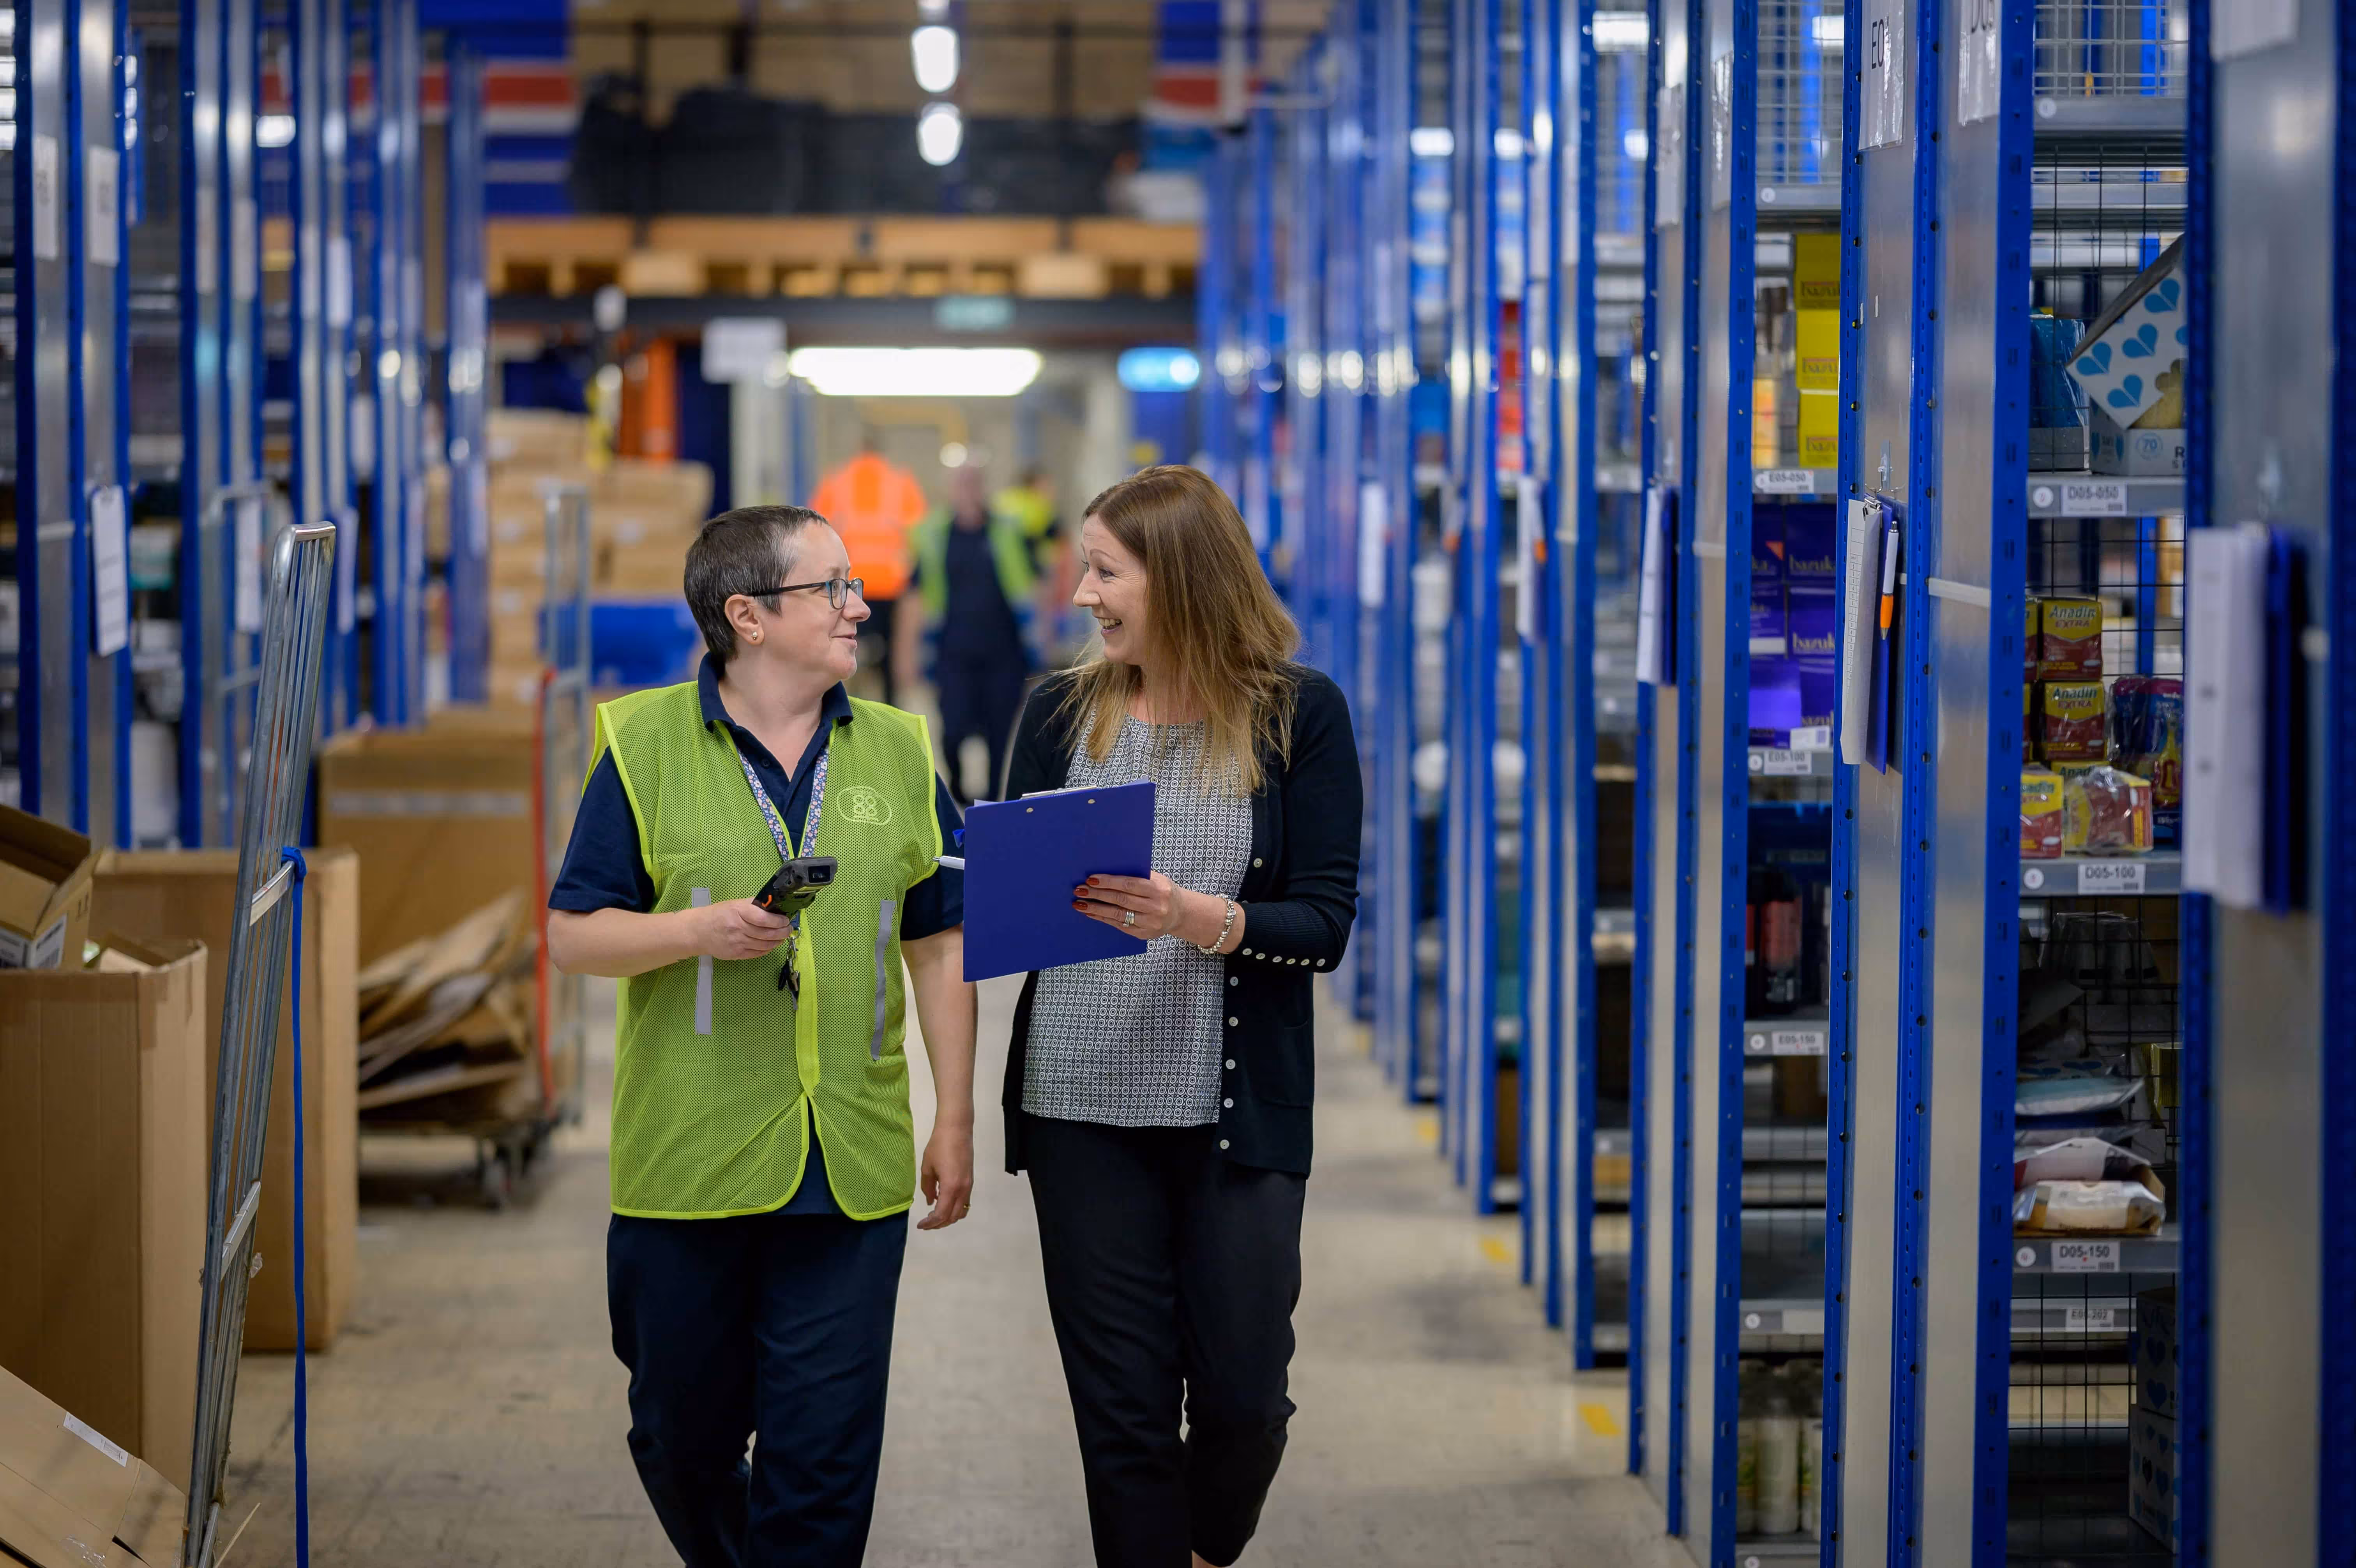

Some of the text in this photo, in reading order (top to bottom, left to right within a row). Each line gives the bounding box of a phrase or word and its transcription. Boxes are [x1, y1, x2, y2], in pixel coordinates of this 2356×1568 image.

[1871, 17, 1890, 69] E0
[1769, 471, 1806, 483] E05-050
[2068, 486, 2119, 500] D05-050
[2052, 685, 2098, 699] Anadin
[1768, 751, 1805, 762] E05-100
[2085, 866, 2136, 879] D05-100
[2059, 1245, 2110, 1258] D05-150
